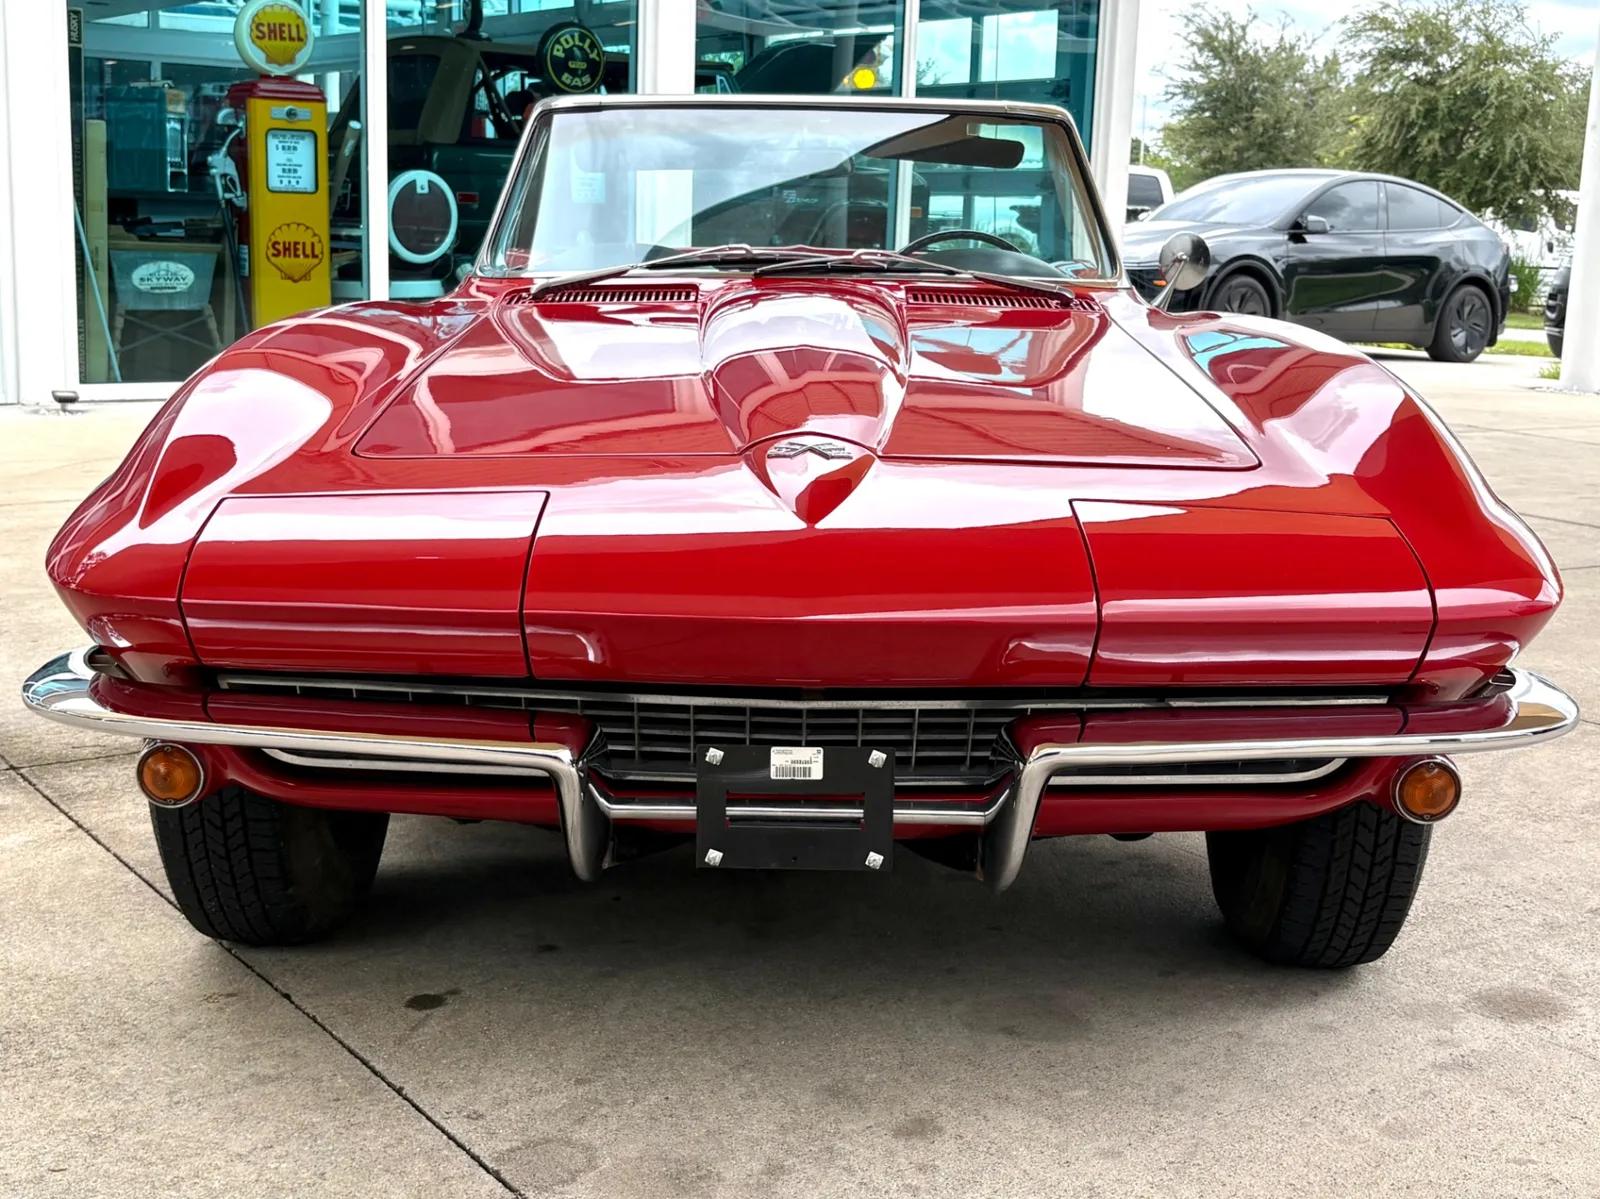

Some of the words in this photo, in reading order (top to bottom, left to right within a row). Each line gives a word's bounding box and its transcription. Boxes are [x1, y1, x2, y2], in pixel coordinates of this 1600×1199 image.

[255, 22, 305, 42] SHELL
[553, 32, 600, 61] POLLY
[561, 72, 591, 87] GAS
[271, 240, 319, 259] SHELL
